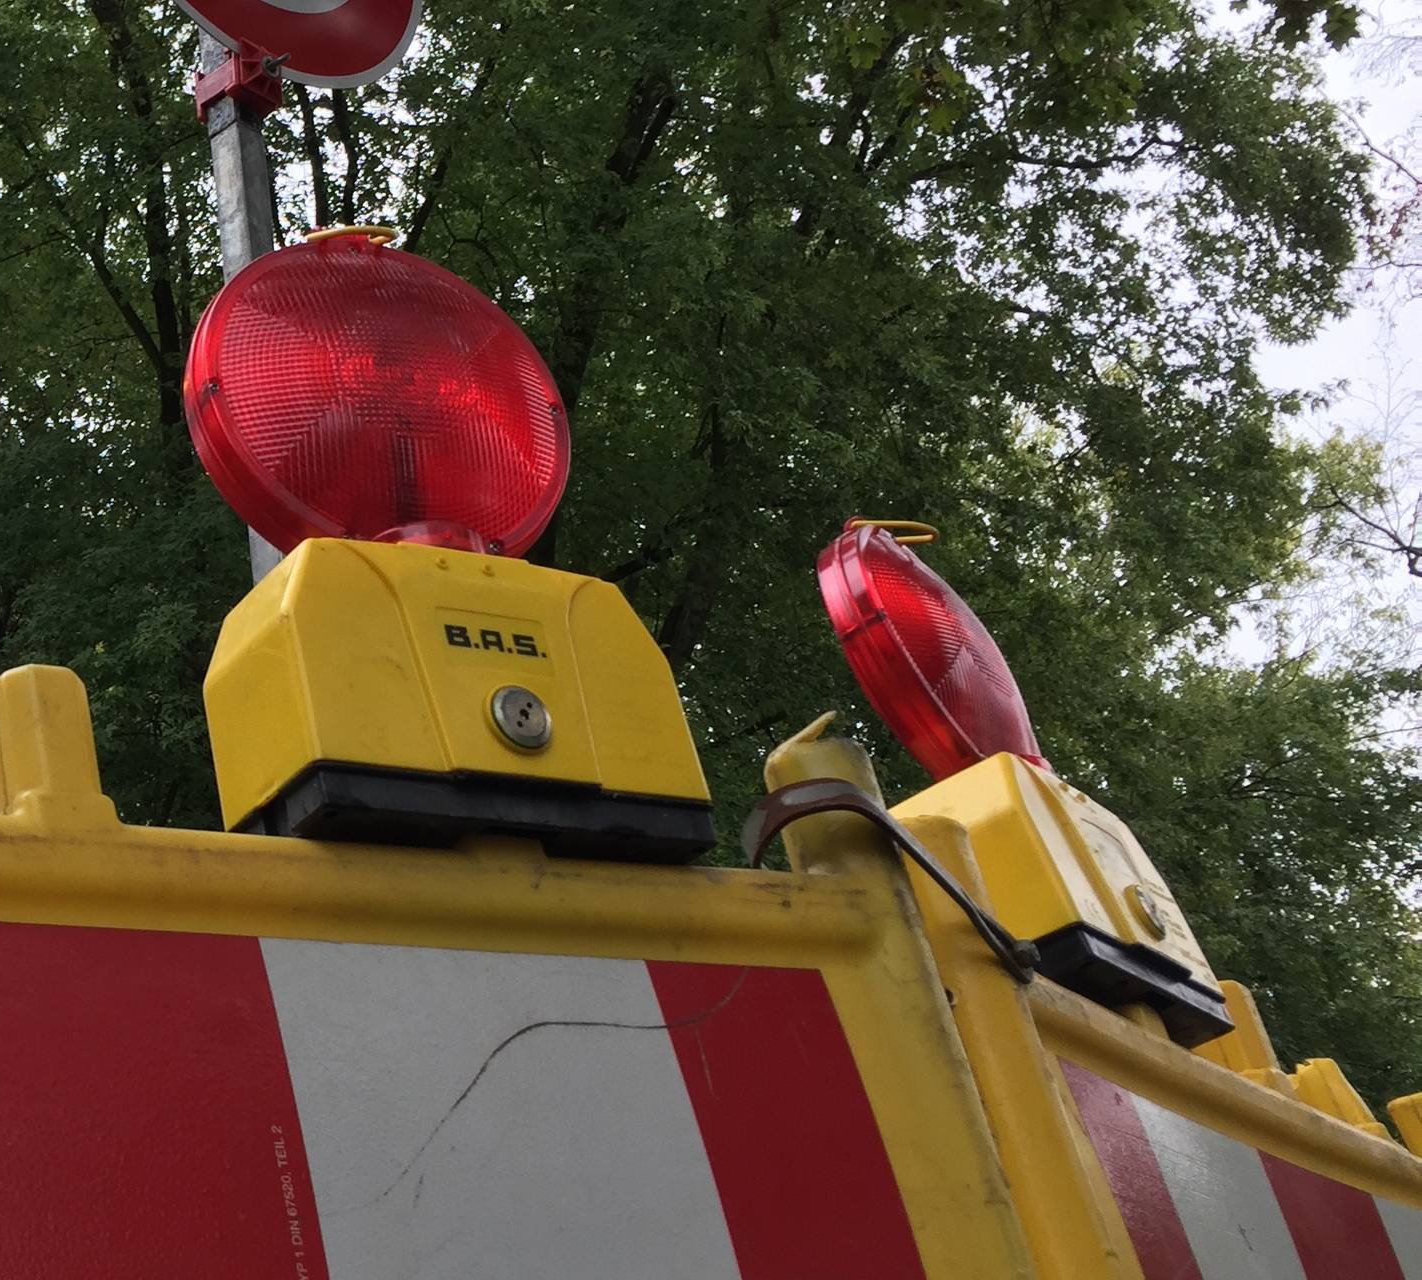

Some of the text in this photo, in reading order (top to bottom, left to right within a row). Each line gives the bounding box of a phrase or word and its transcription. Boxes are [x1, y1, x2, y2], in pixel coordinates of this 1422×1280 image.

[444, 623, 547, 659] B.A.S.
[271, 1124, 283, 1134] 2
[274, 1137, 288, 1168] TEIL
[289, 1220, 303, 1245] DIN
